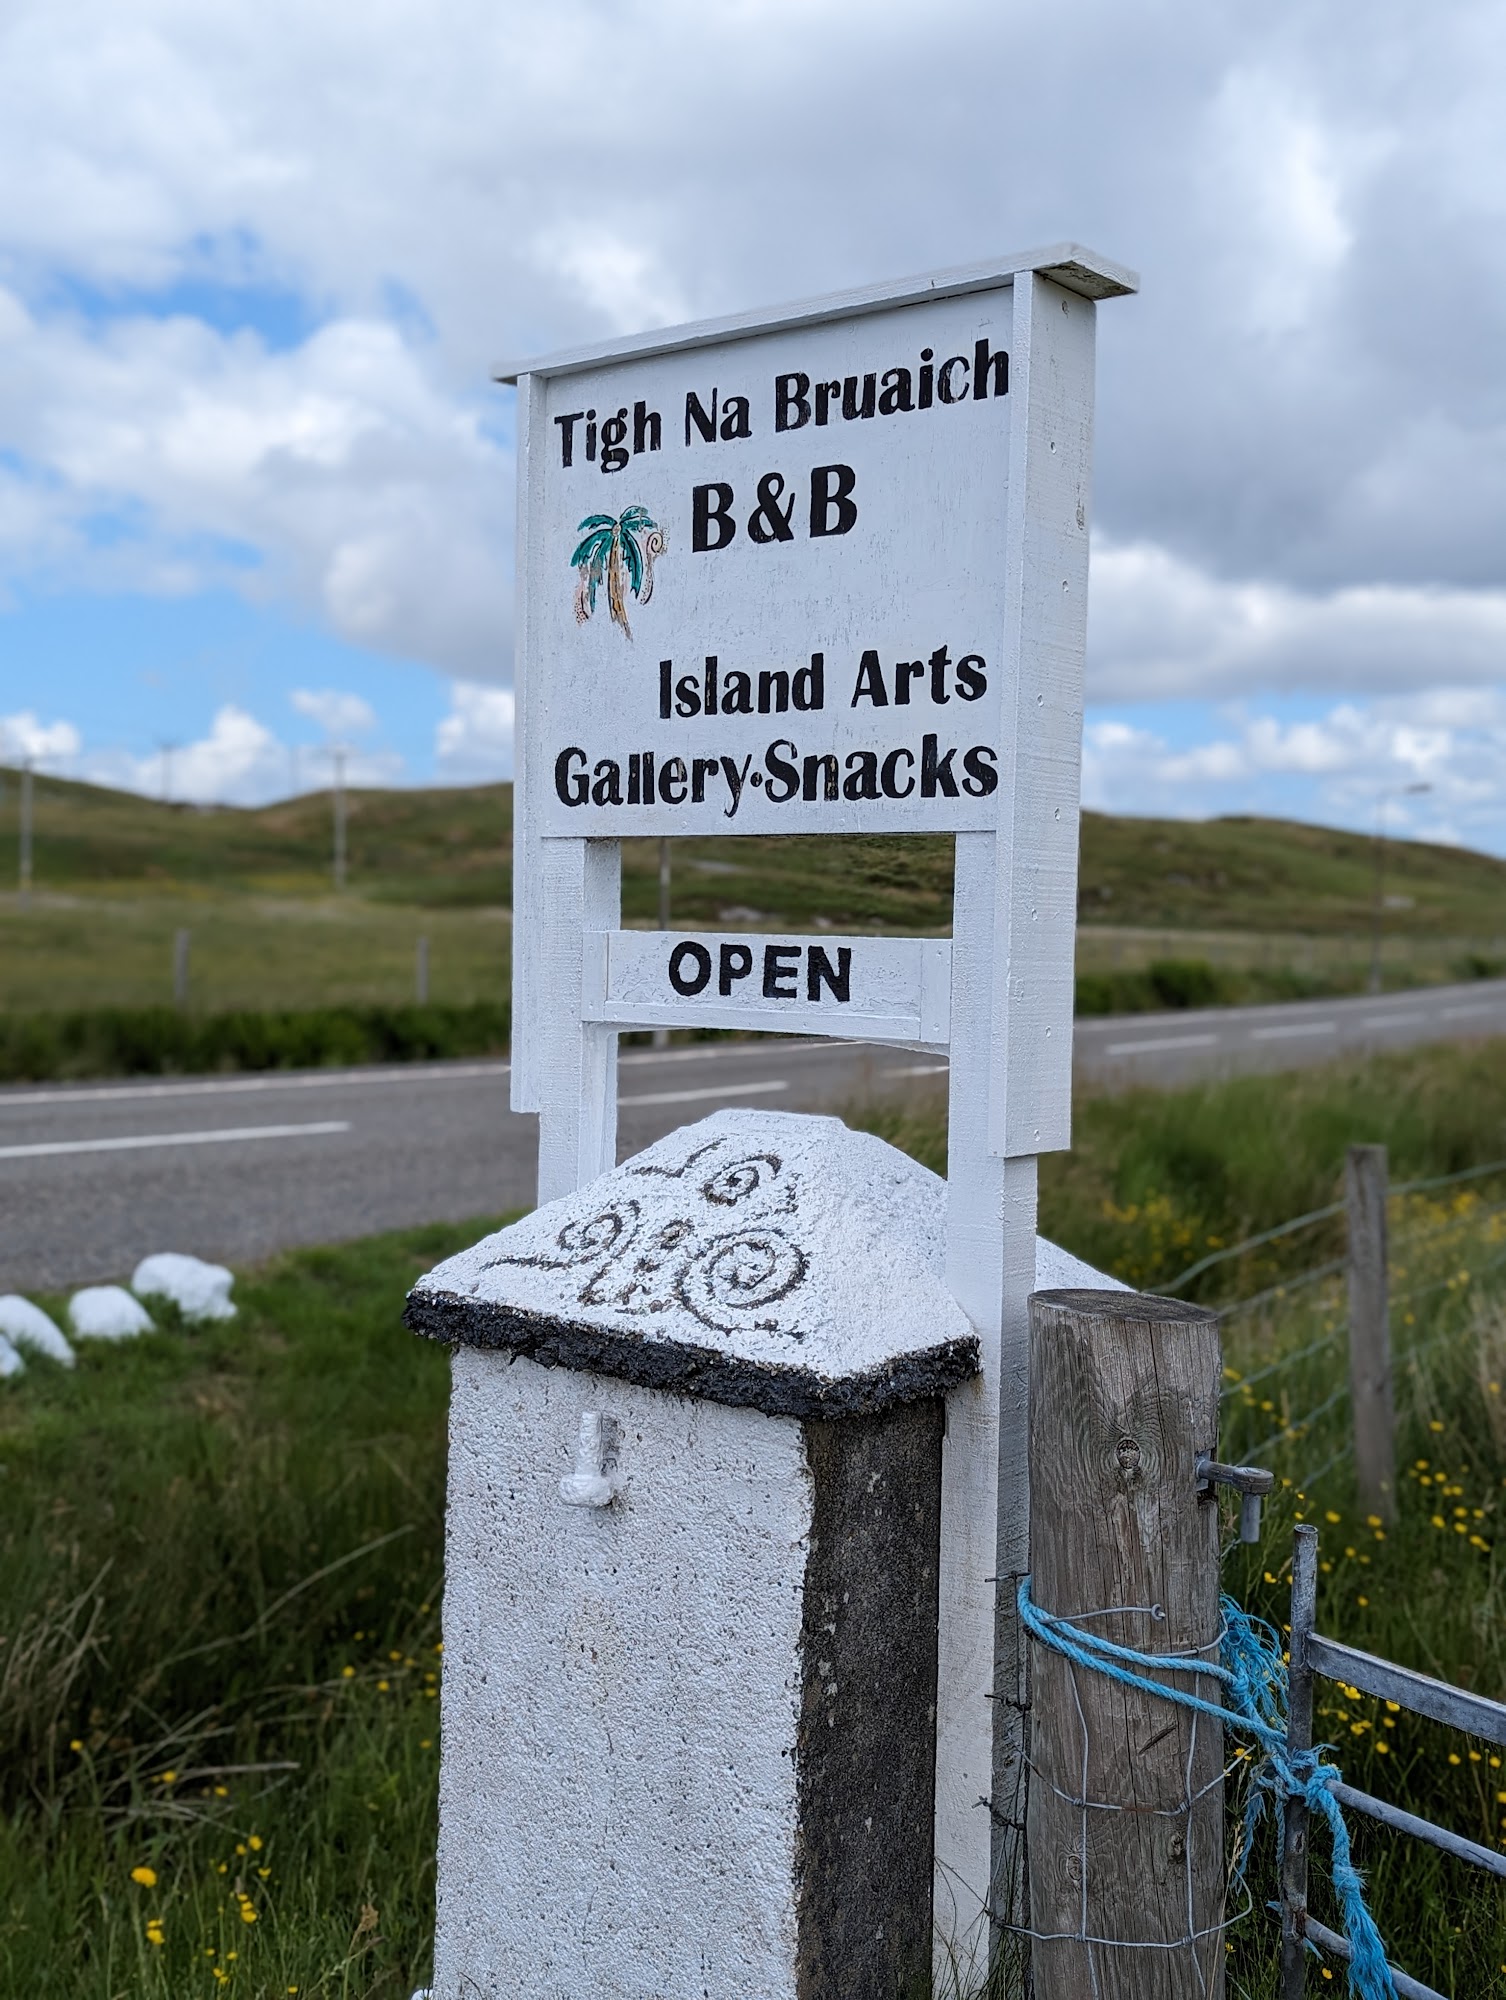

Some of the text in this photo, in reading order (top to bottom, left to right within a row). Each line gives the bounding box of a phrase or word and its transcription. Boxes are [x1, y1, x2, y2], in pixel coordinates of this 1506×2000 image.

[553, 337, 1011, 474] Tigh Na Bruaich
[691, 462, 859, 554] B&B
[658, 643, 989, 720] Island Arts
[667, 940, 853, 1004] OPEN
